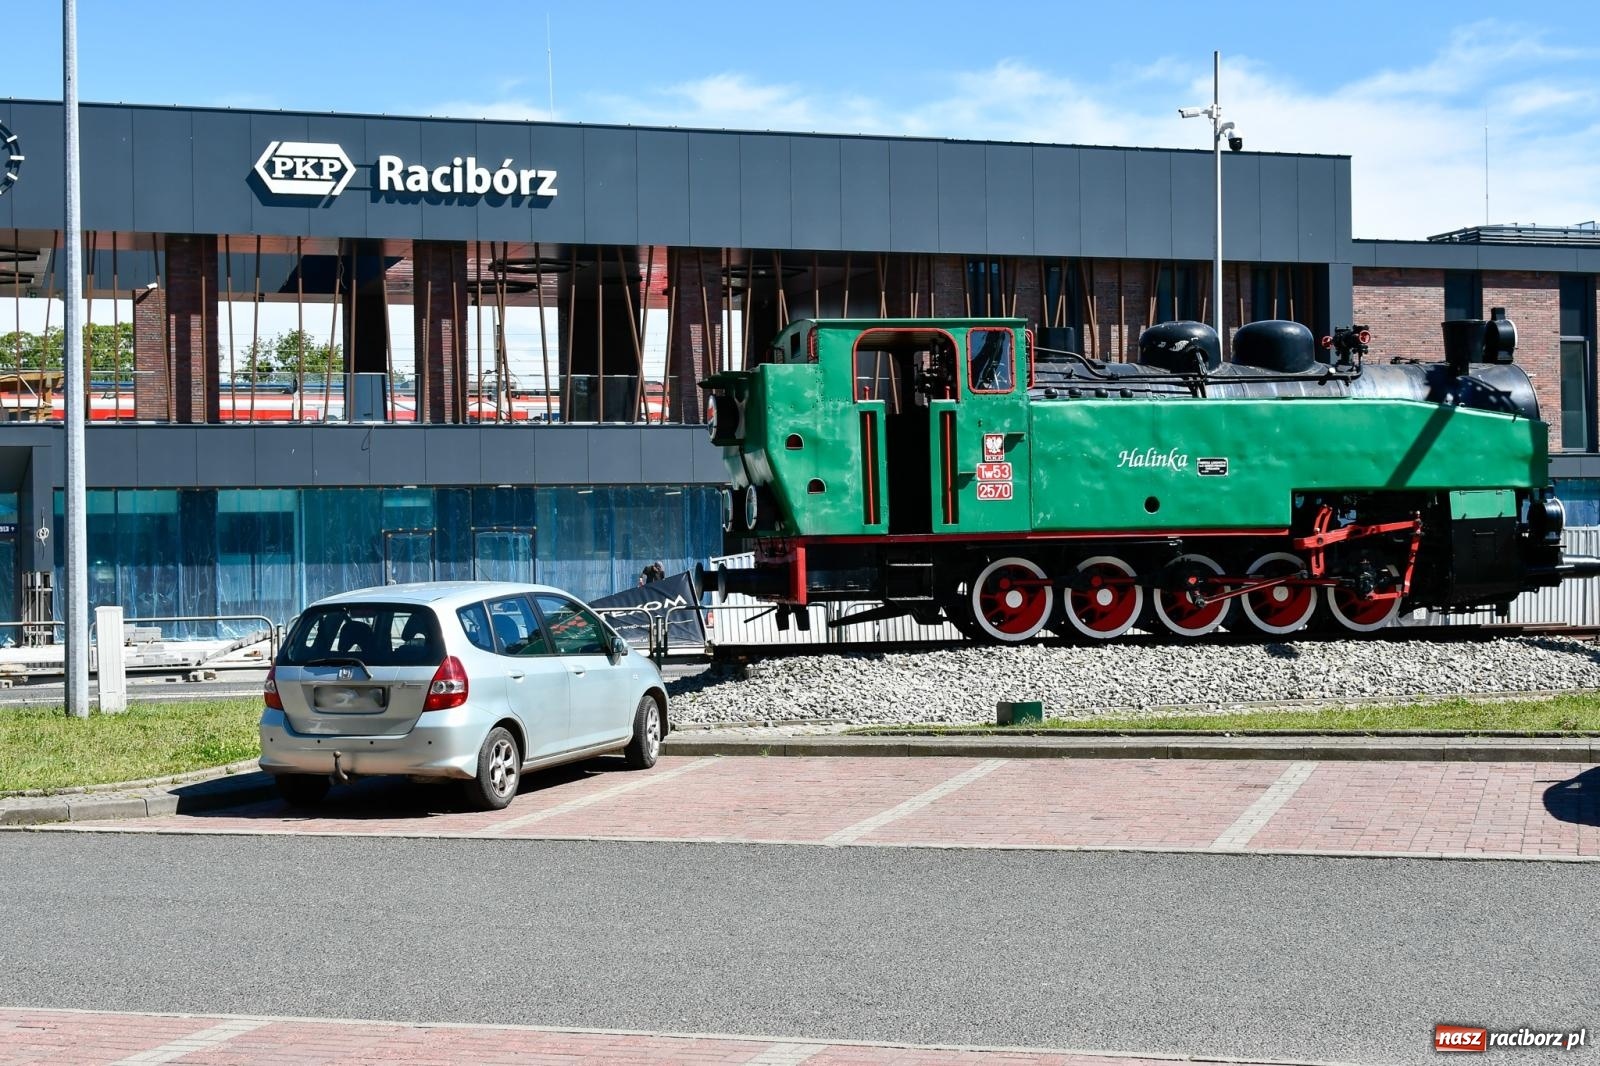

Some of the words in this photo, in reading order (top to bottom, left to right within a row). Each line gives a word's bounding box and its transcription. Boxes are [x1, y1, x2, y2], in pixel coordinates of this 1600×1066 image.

[271, 156, 341, 180] PKP
[379, 155, 557, 196] Racibórz
[1116, 447, 1188, 472] Halinka
[979, 464, 1010, 479] Tw53
[979, 483, 1011, 498] 2570
